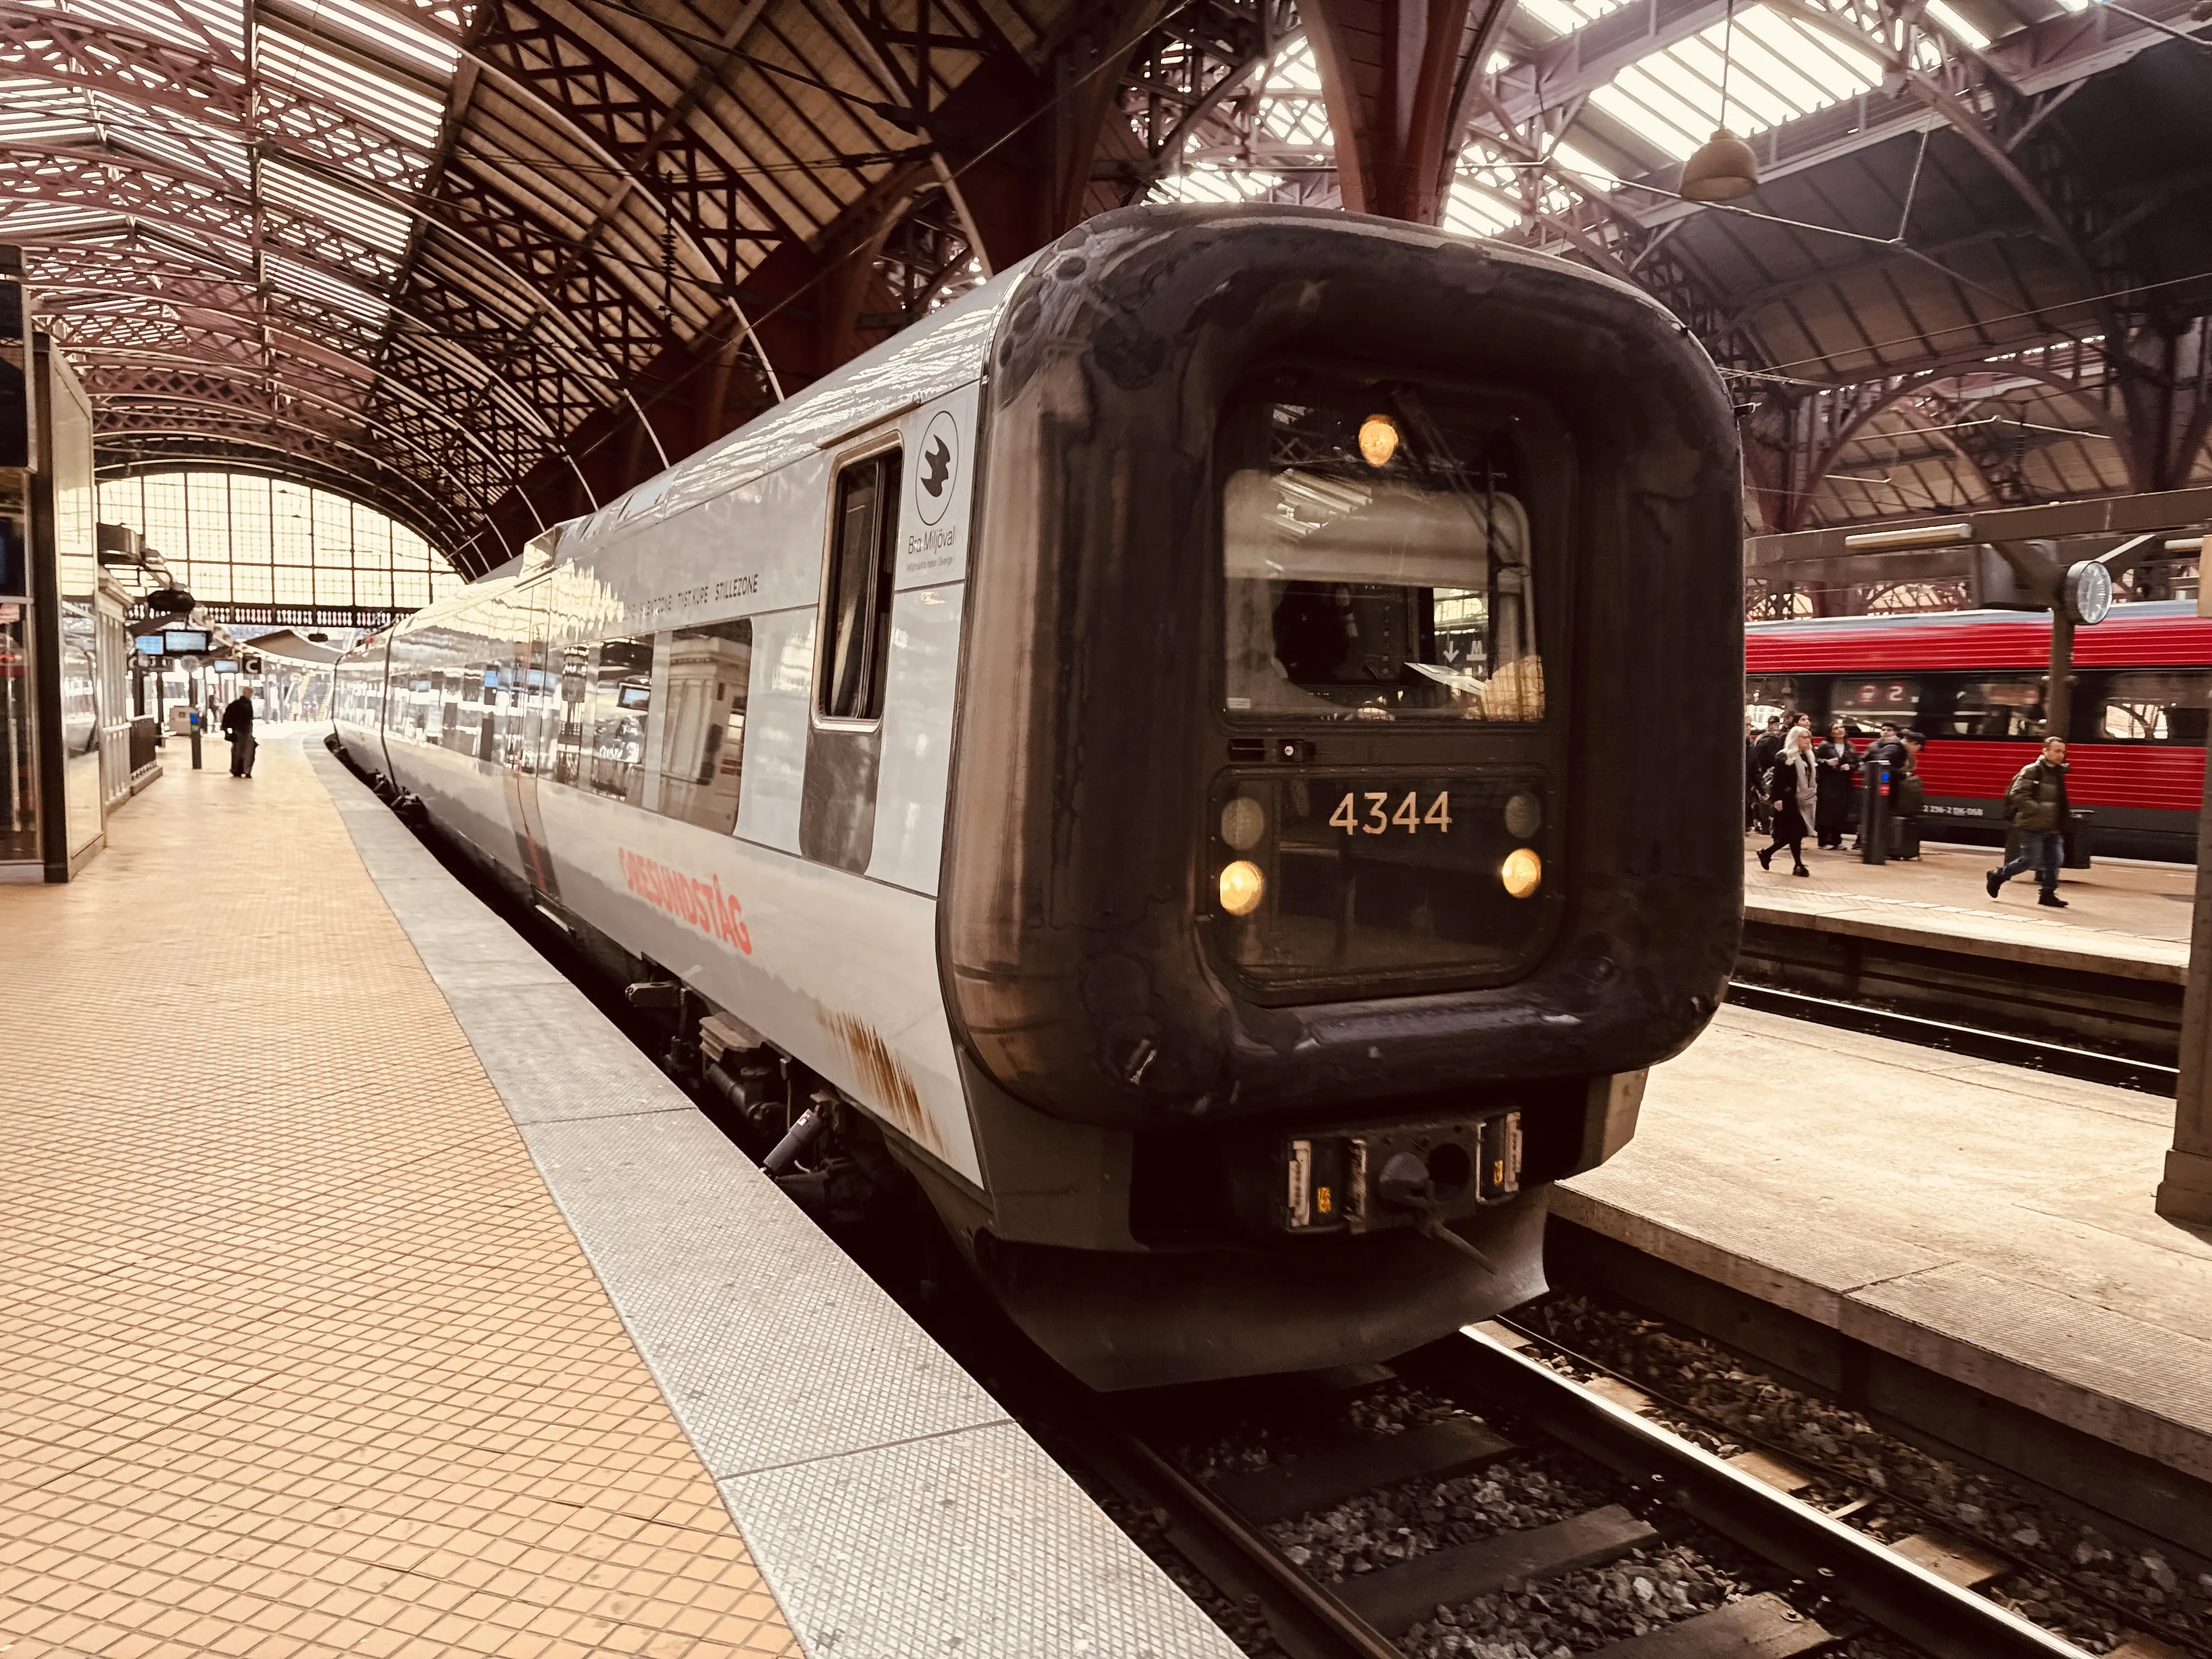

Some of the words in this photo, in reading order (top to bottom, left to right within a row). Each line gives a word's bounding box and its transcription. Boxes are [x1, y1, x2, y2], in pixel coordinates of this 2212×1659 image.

[909, 535, 922, 554] Bra
[924, 526, 955, 554] Miljöval
[715, 573, 758, 601] STILLEZONE
[245, 659, 258, 673] C
[1889, 685, 1904, 701] 2
[1329, 791, 1453, 836] 4344
